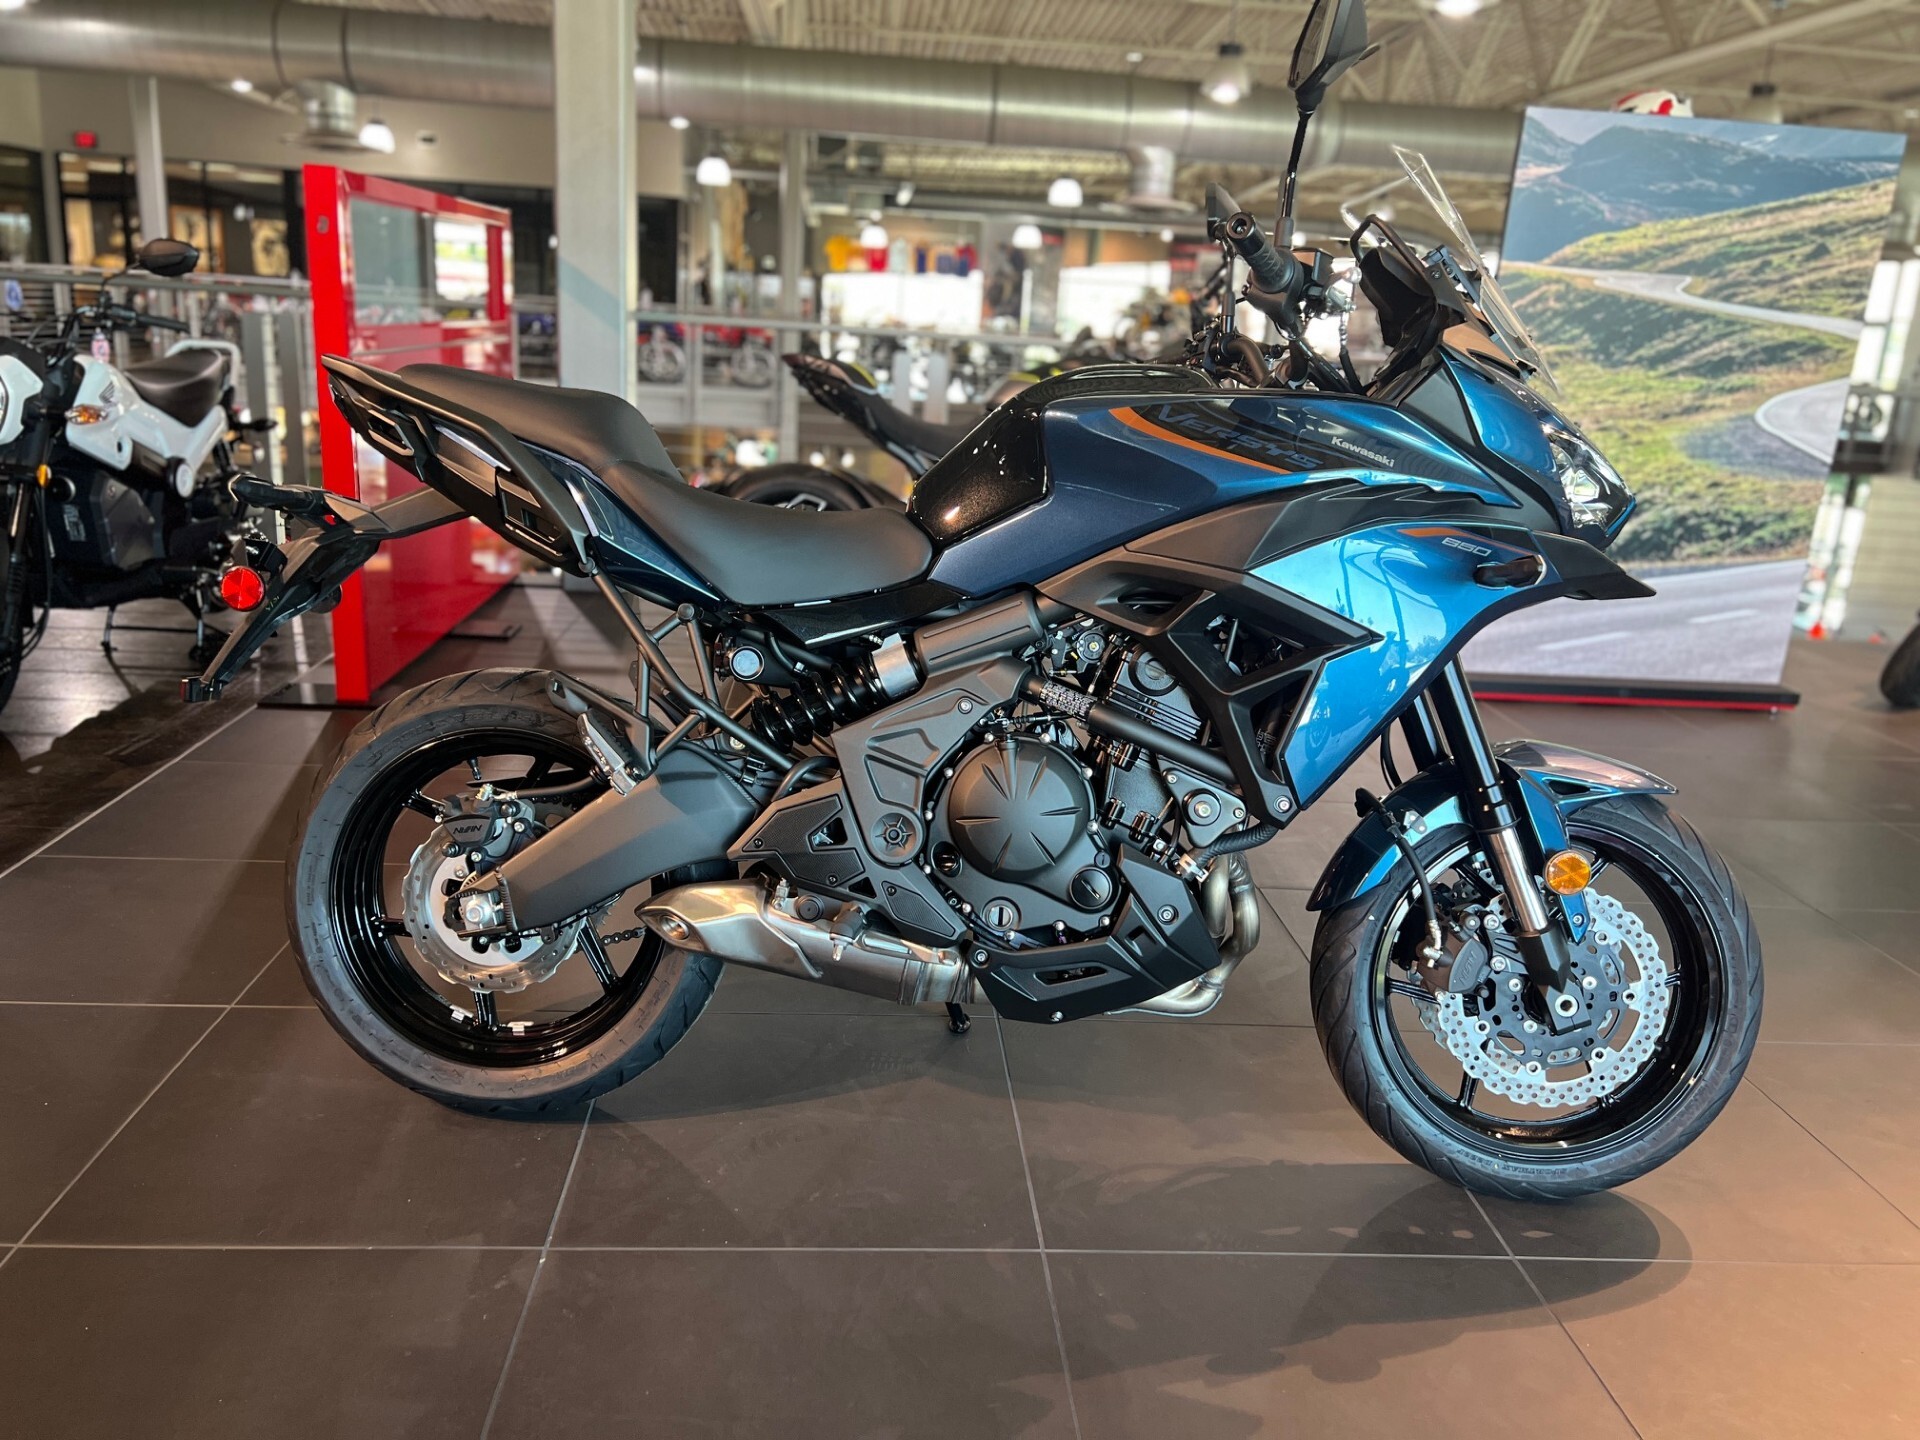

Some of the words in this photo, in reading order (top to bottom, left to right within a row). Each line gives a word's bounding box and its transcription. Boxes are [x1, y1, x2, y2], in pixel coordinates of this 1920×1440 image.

[1158, 404, 1324, 469] VERSYS
[1331, 436, 1395, 468] Kawasaki
[1441, 537, 1492, 556] 650
